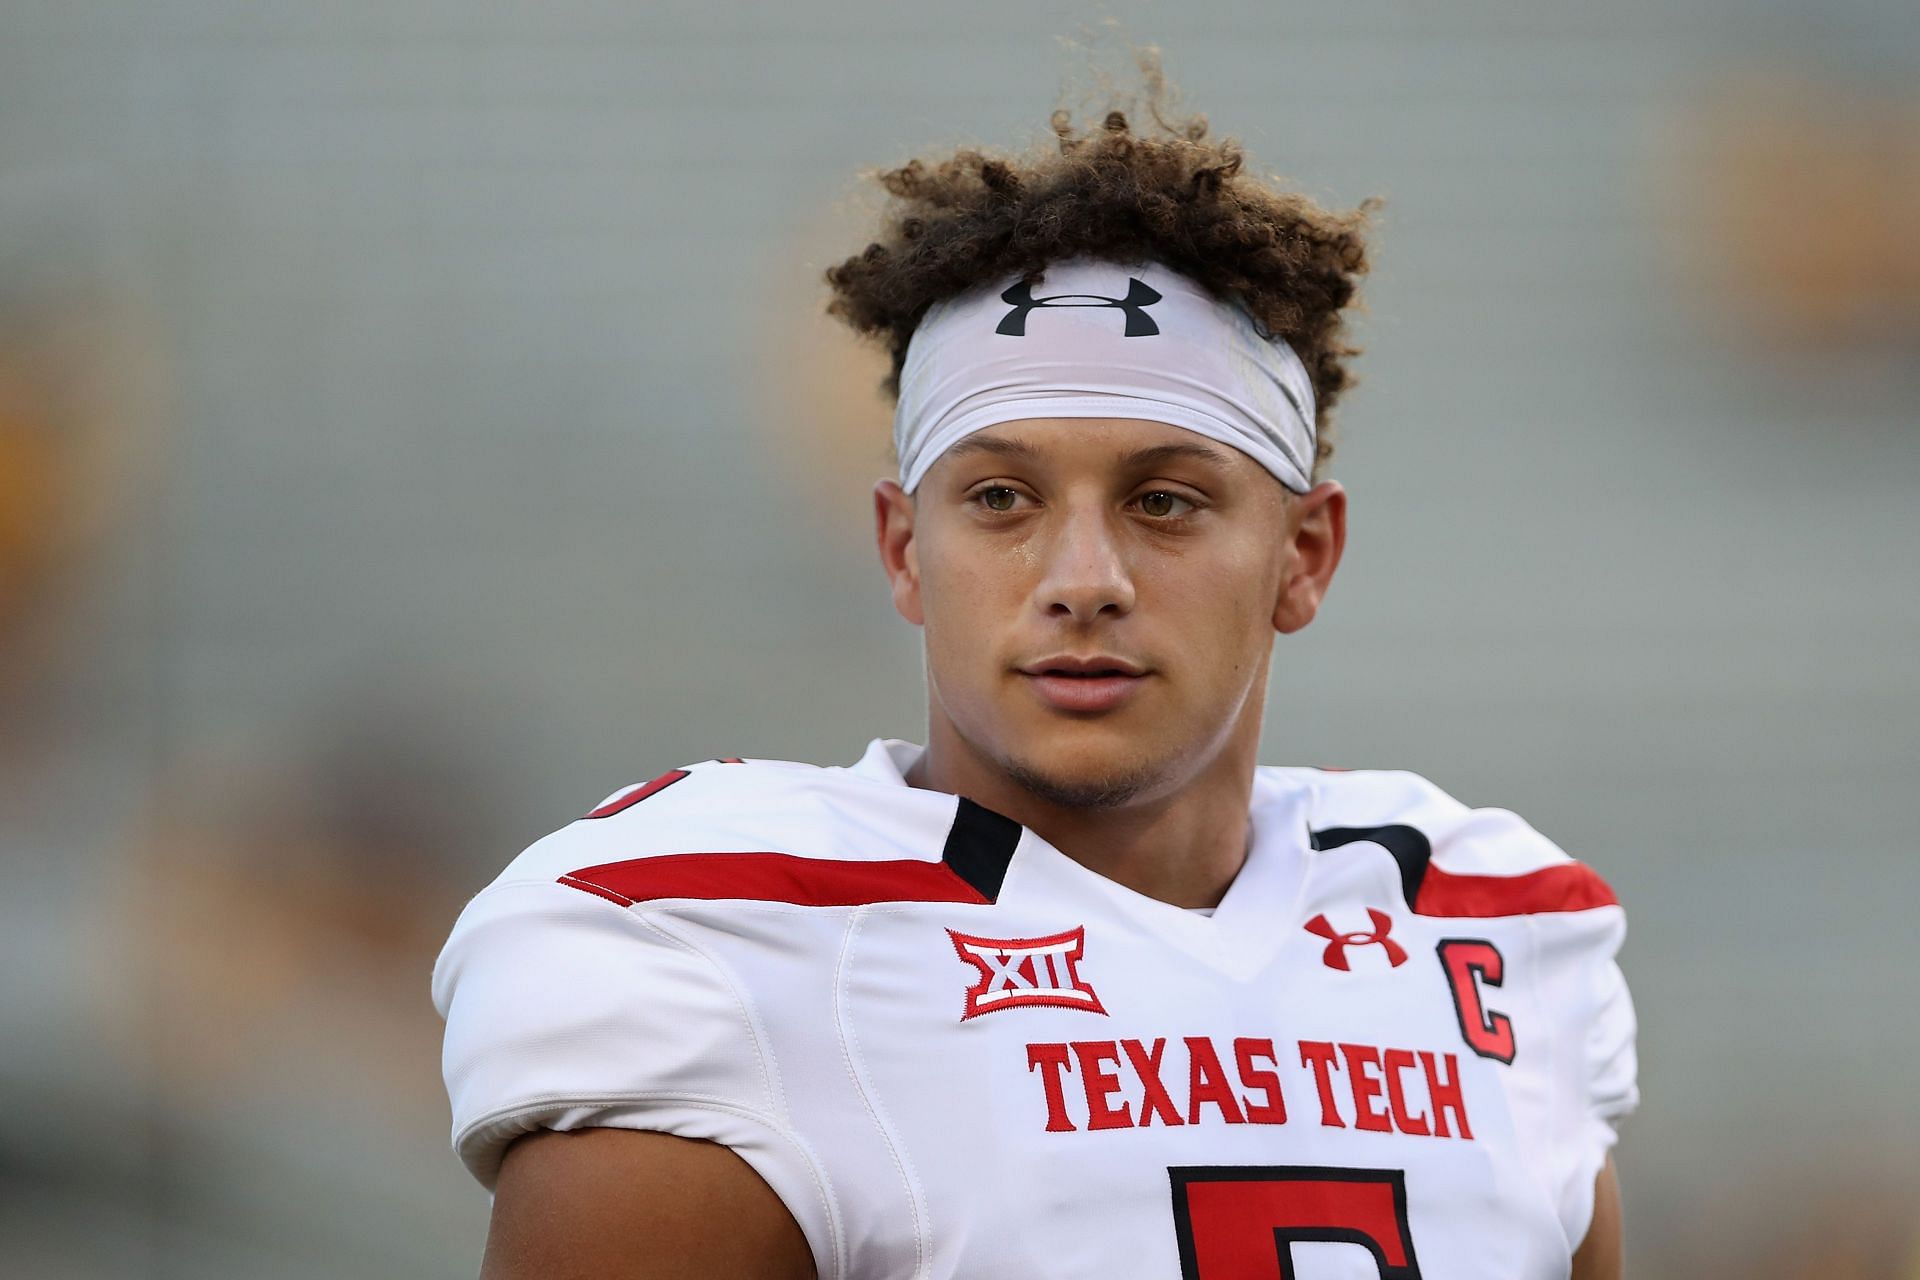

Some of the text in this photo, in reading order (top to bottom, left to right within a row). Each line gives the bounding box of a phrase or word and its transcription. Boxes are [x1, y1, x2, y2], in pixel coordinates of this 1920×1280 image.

[962, 938, 1094, 1007] XII
[1435, 938, 1517, 1066] C
[1026, 1036, 1474, 1141] TEXAS TECH
